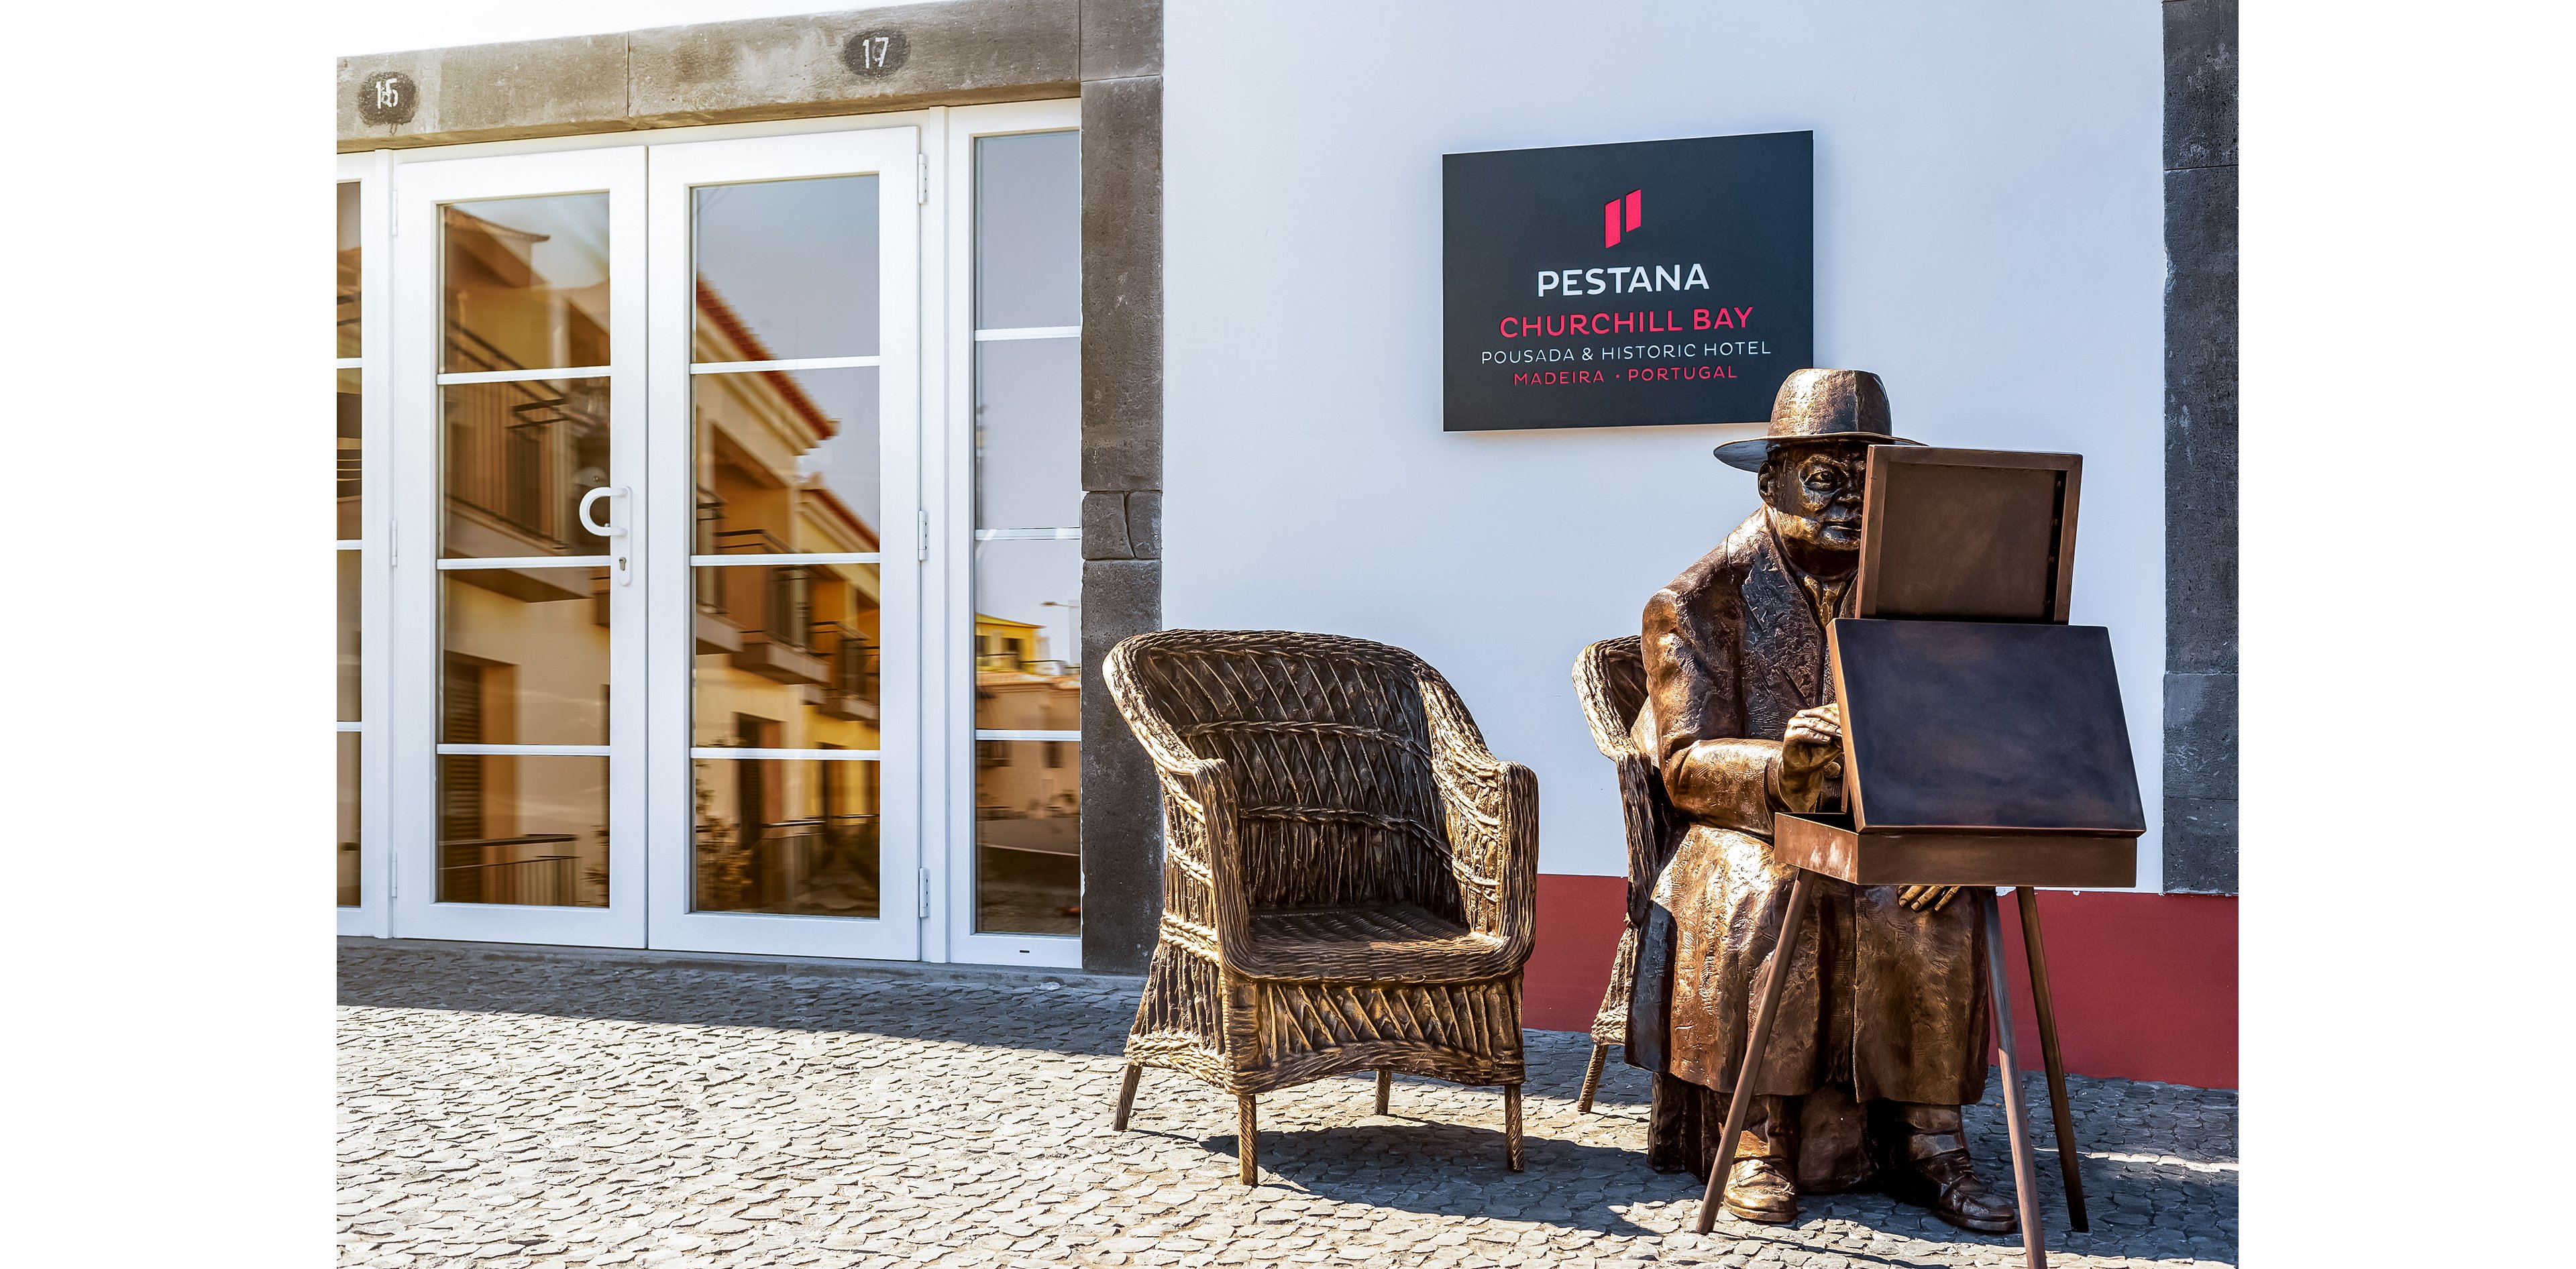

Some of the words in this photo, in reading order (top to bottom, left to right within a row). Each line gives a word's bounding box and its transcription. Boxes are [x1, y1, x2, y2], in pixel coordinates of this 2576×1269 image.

[862, 36, 890, 69] 17
[1538, 264, 1710, 297] PESTANA
[1499, 310, 1683, 338] CHURCHILL
[1693, 307, 1753, 331] BAY
[1482, 348, 1574, 365] POUSADA
[1581, 347, 1593, 361] &
[1602, 343, 1696, 360] HISTORIC
[1704, 341, 1771, 356] HOTEL
[1513, 370, 1604, 386] MADEIRA
[1627, 366, 1737, 382] PORTUGAL
